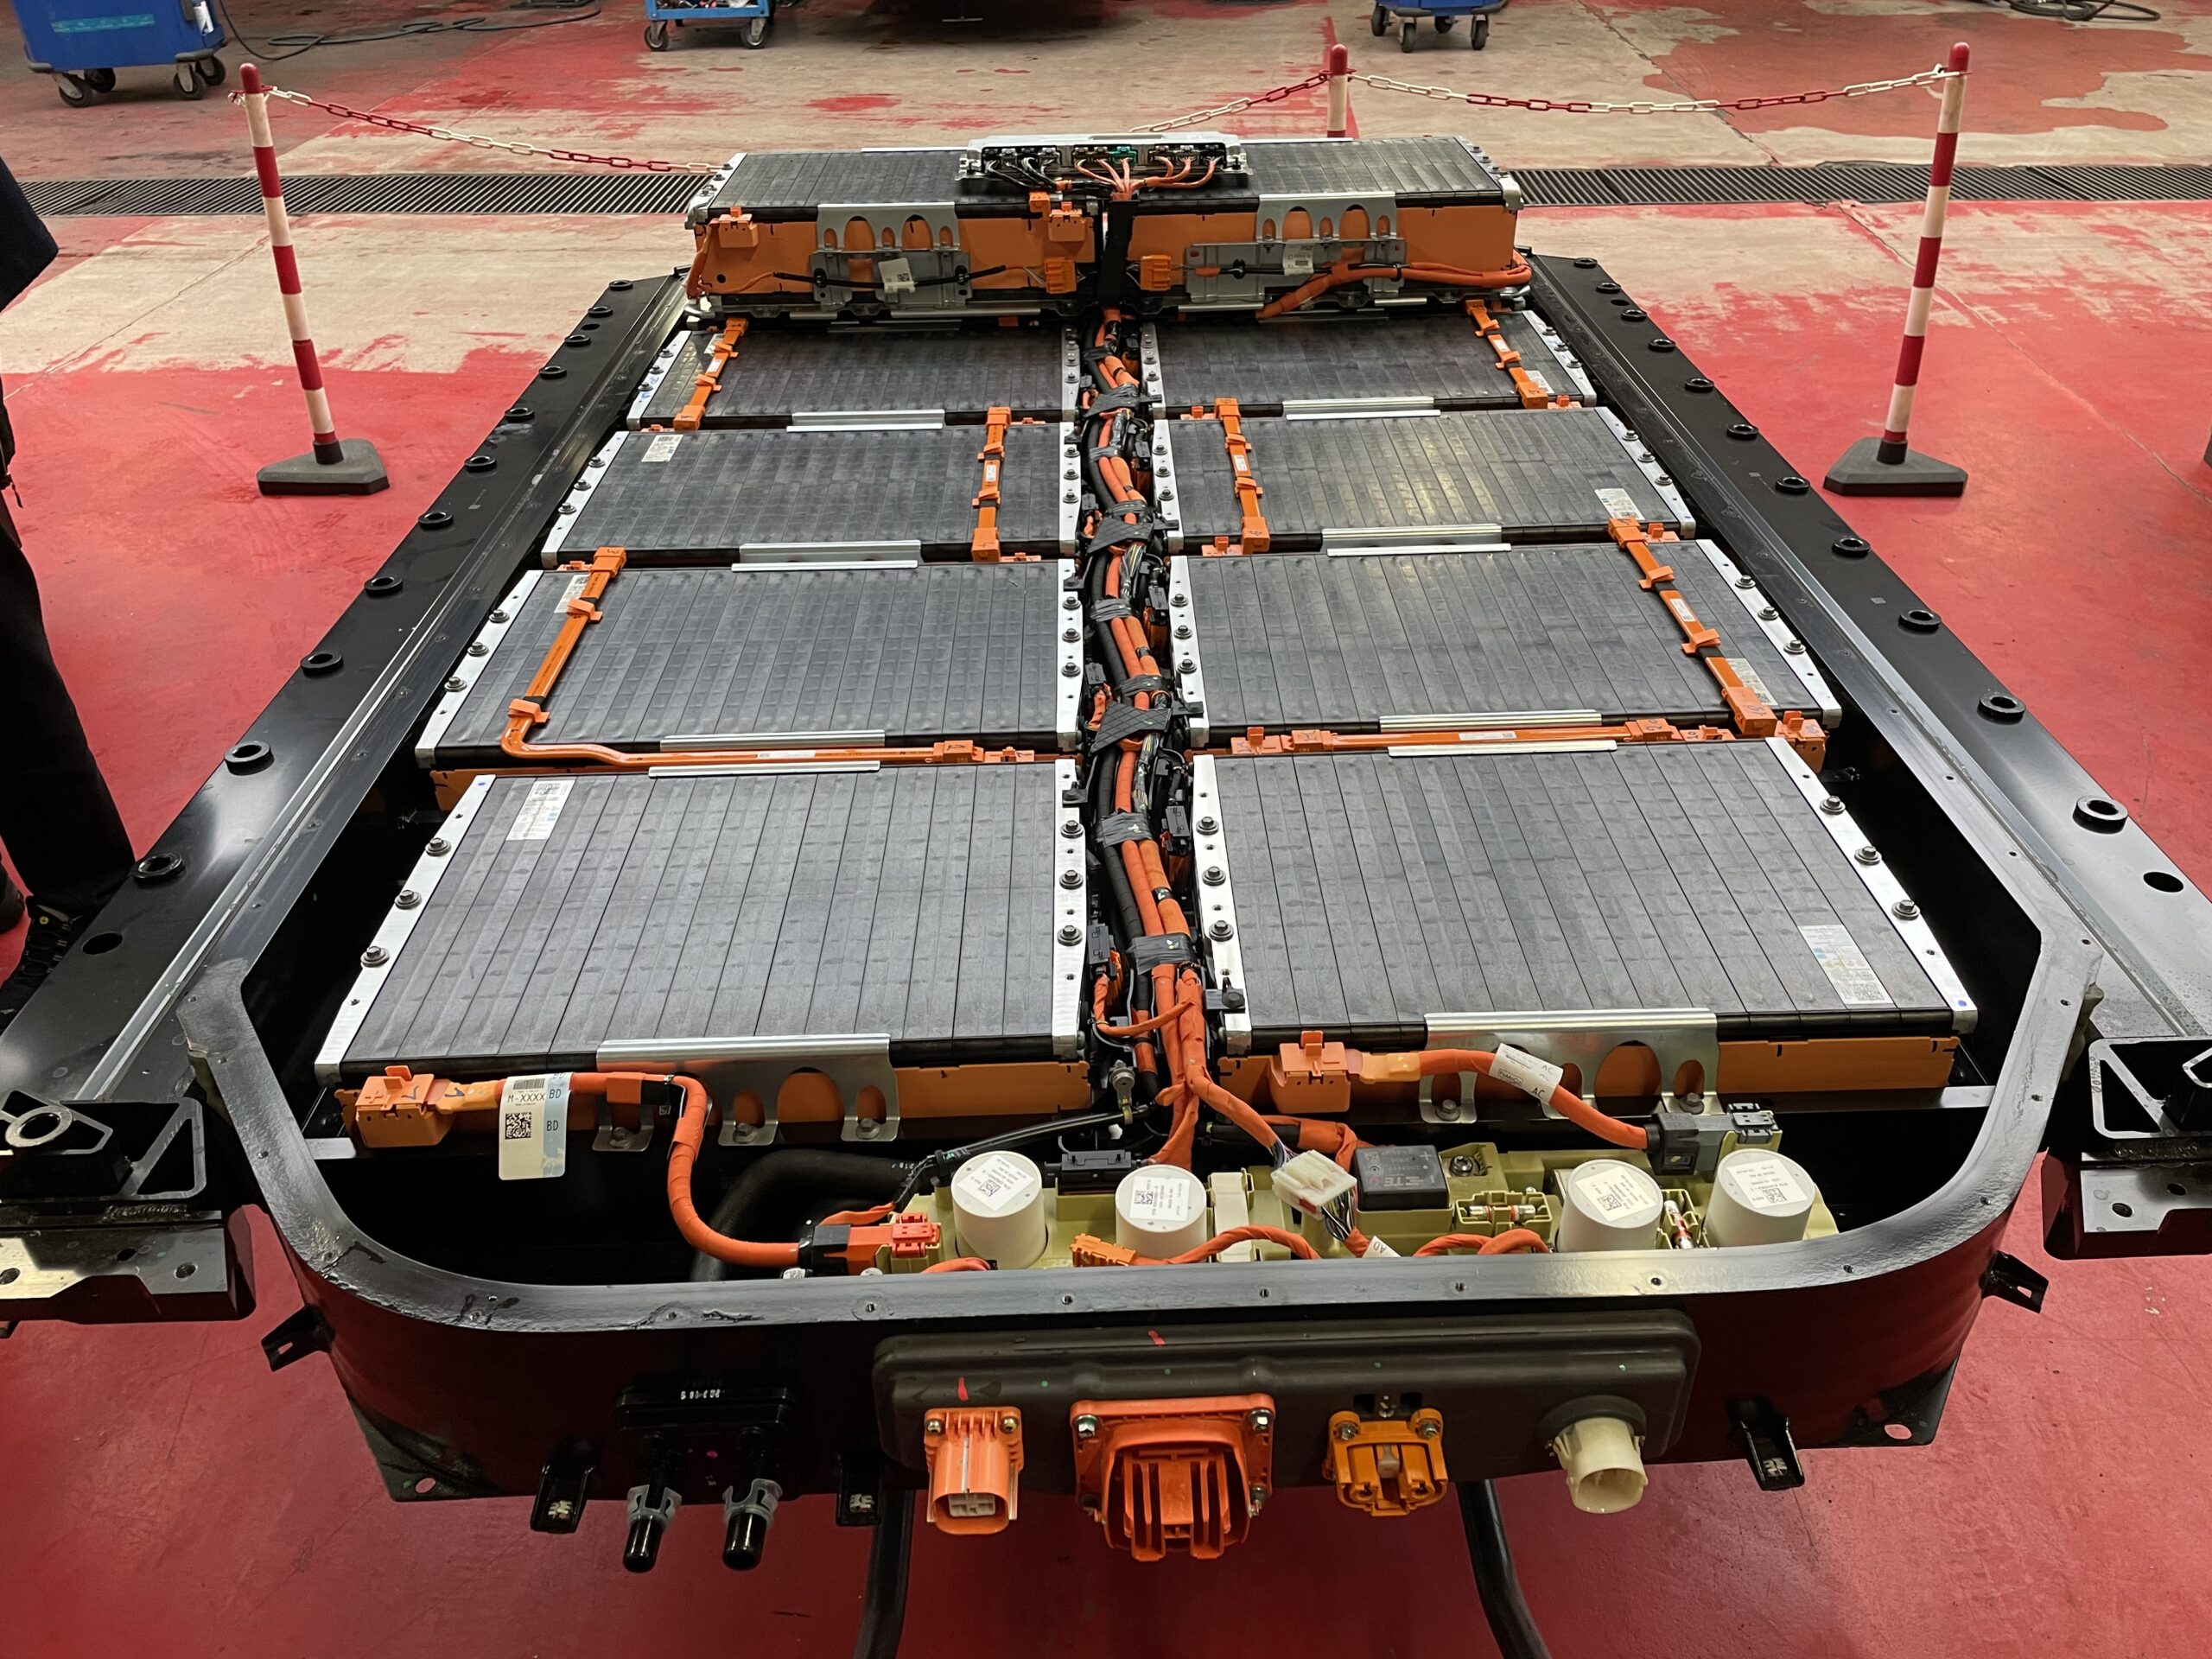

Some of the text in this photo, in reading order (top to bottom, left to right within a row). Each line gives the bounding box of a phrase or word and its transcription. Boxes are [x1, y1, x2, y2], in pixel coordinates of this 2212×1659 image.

[1541, 1065, 1554, 1073] AC
[507, 1093, 545, 1103] M-XXXX
[549, 1089, 561, 1099] BD
[1531, 1087, 1546, 1099] AC
[546, 1120, 559, 1131] BD
[1382, 1176, 1403, 1186] TE
[1373, 1241, 1387, 1254] AD
